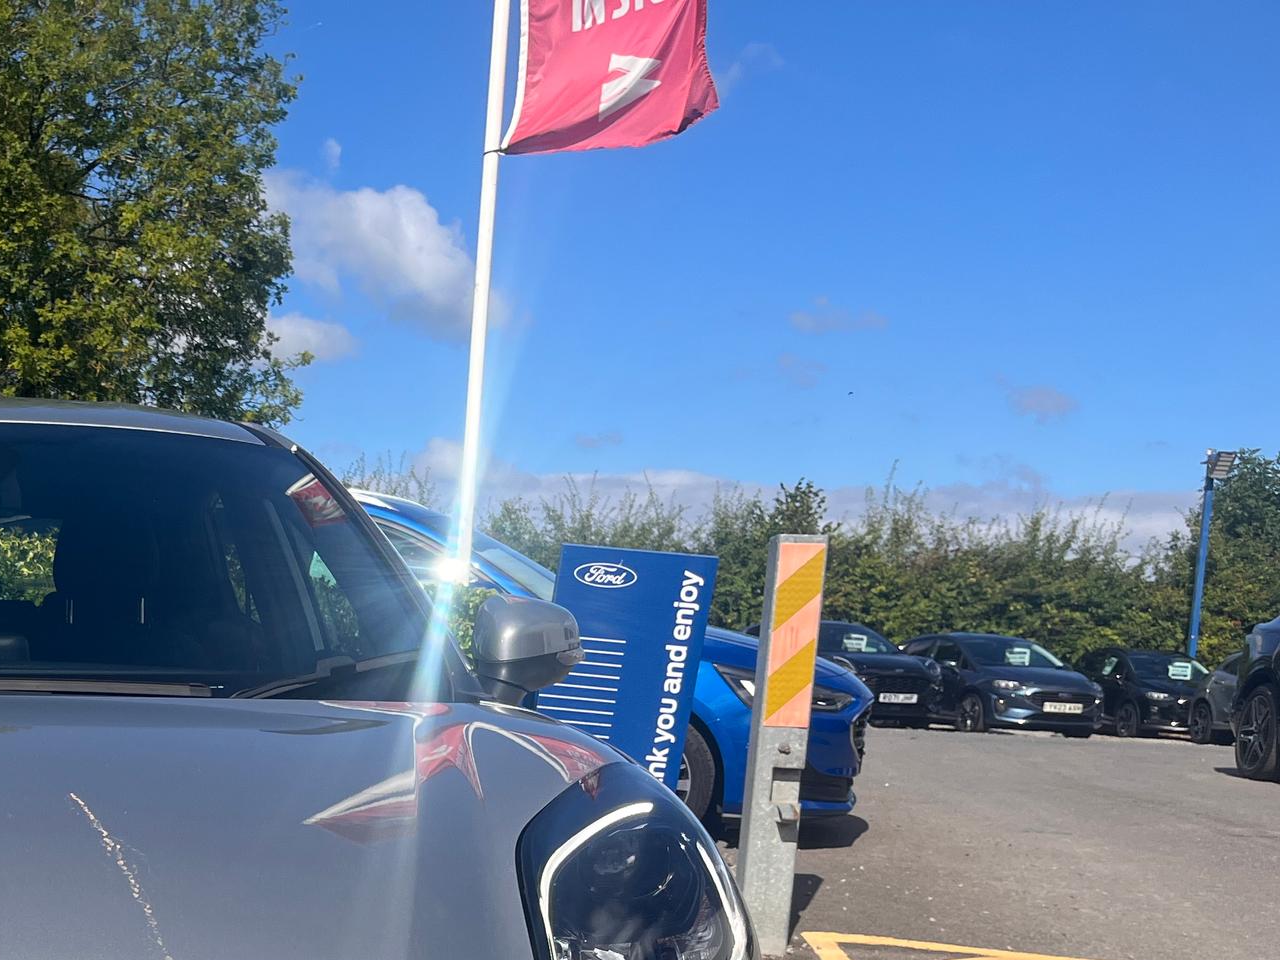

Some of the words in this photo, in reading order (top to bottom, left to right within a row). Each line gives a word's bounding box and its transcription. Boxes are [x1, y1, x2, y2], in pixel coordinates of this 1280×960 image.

[584, 565, 627, 585] Ford
[673, 570, 705, 641] enjoy
[663, 645, 688, 694] and
[654, 697, 678, 744] you
[645, 747, 670, 783] nk
